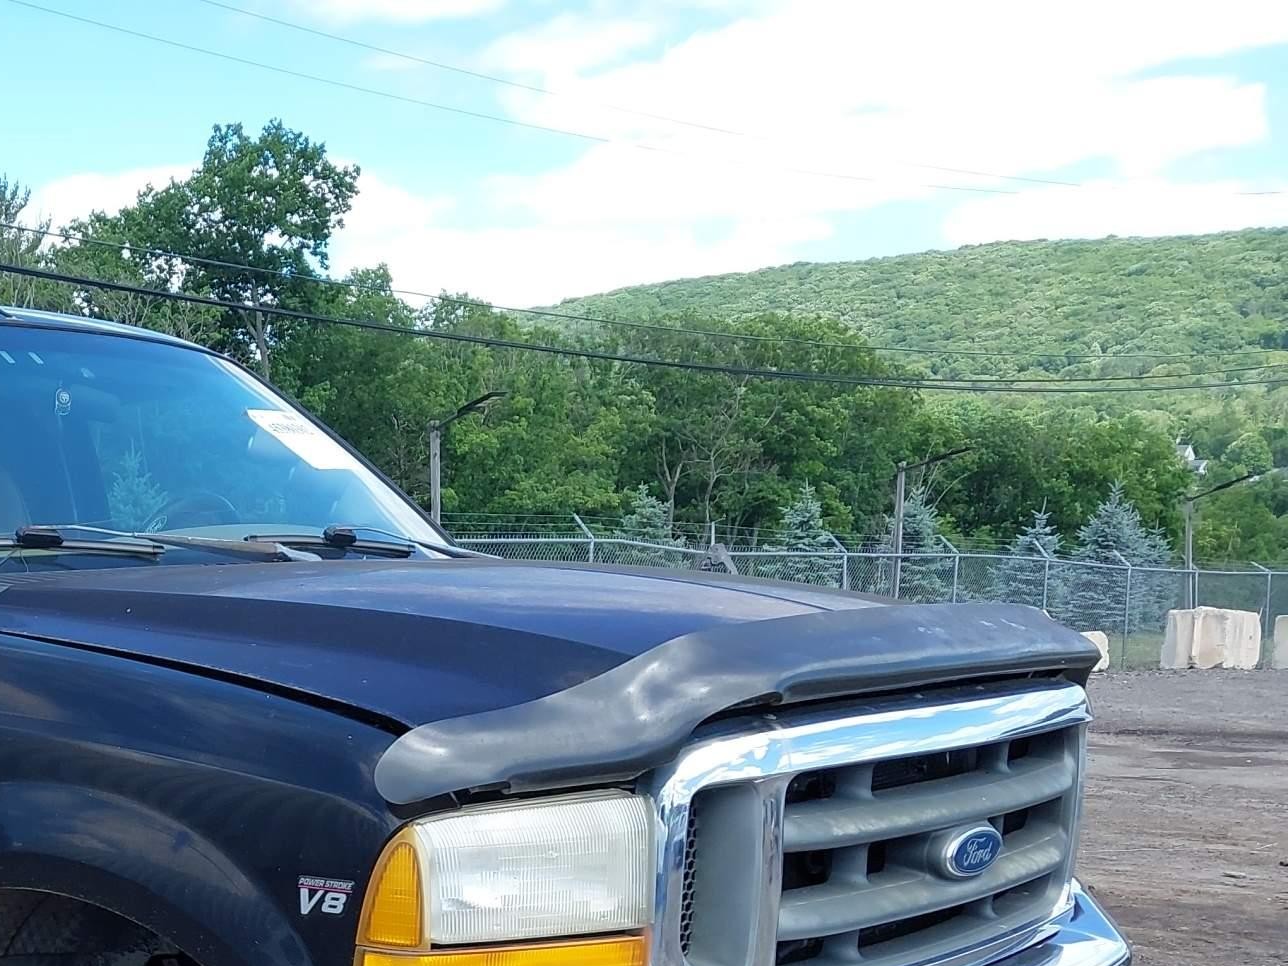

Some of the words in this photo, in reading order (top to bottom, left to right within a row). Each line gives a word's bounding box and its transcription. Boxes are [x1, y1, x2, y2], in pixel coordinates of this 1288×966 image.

[963, 837, 993, 867] Ford
[298, 877, 325, 887] POWER
[324, 880, 353, 890] STROKE
[299, 887, 347, 915] V8
